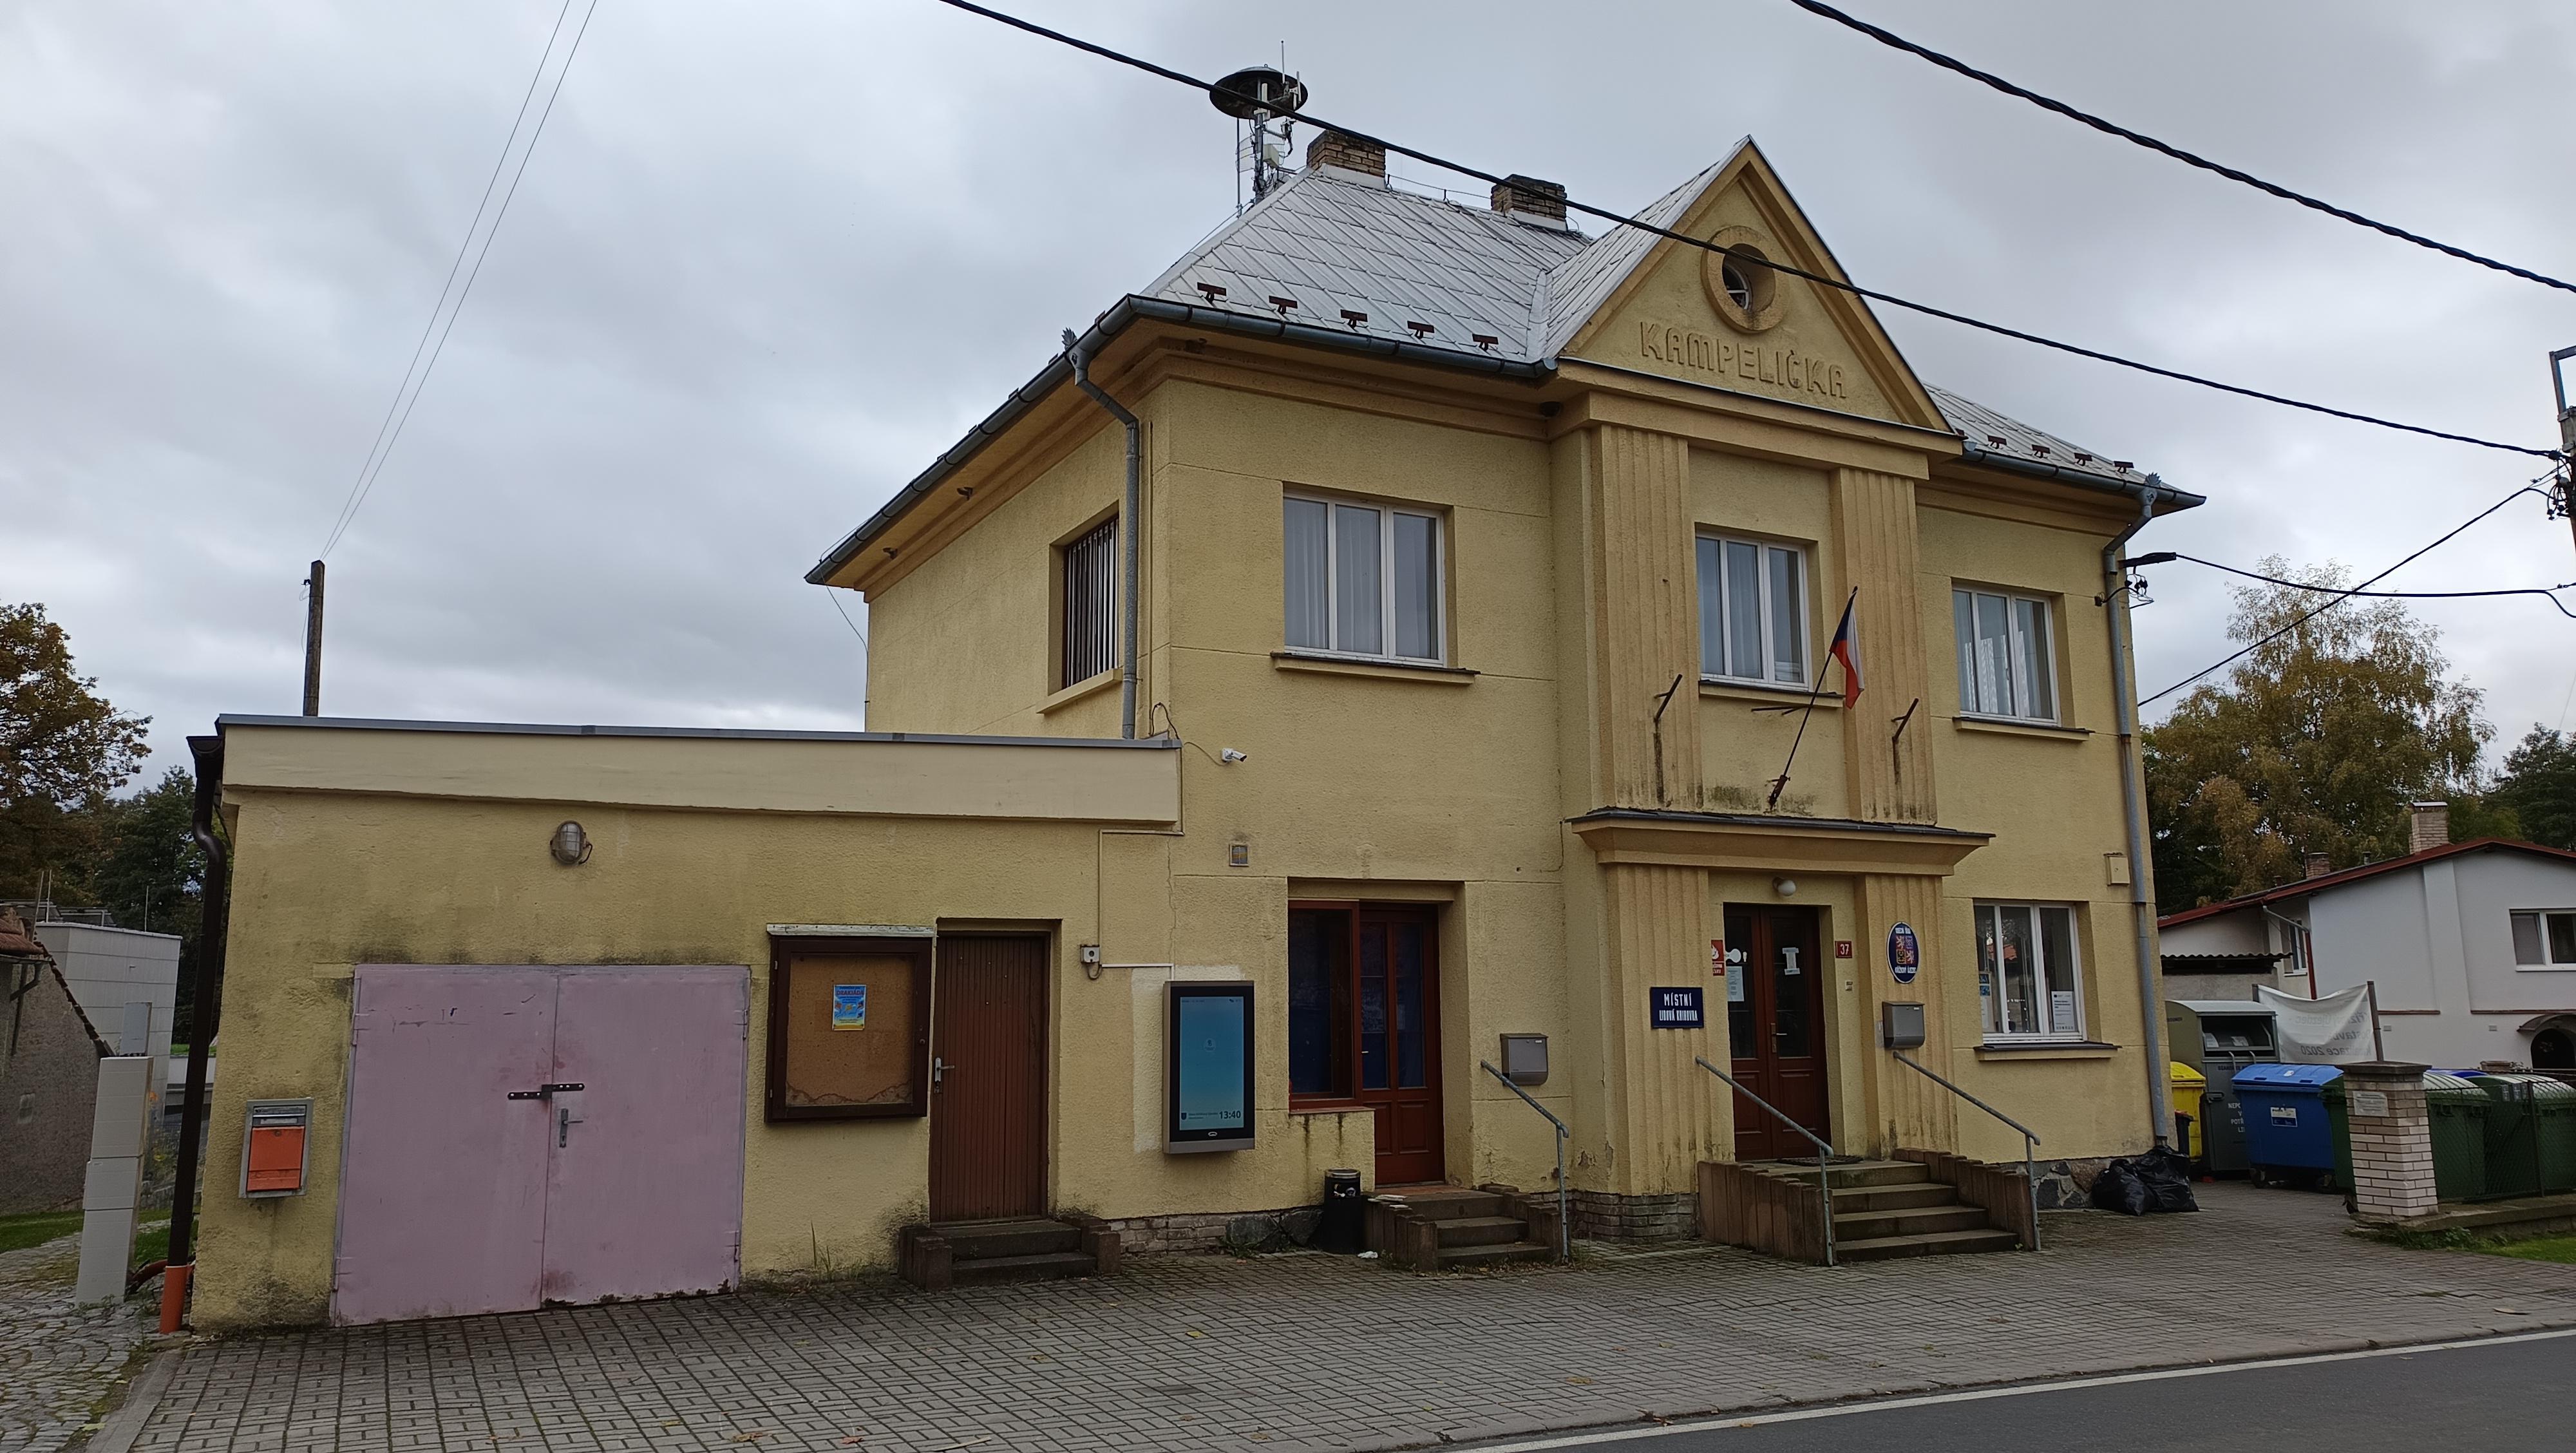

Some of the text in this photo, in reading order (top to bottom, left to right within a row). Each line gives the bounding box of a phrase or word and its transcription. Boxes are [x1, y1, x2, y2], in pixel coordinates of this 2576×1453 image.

[1640, 321, 1847, 399] KAMPELIČKA
[1840, 944, 1850, 956] 37
[1663, 992, 1692, 1007] MÍSTNÍ
[1659, 1009, 1675, 1021] LIDOVÁ
[1219, 1110, 1241, 1119] 13:40
